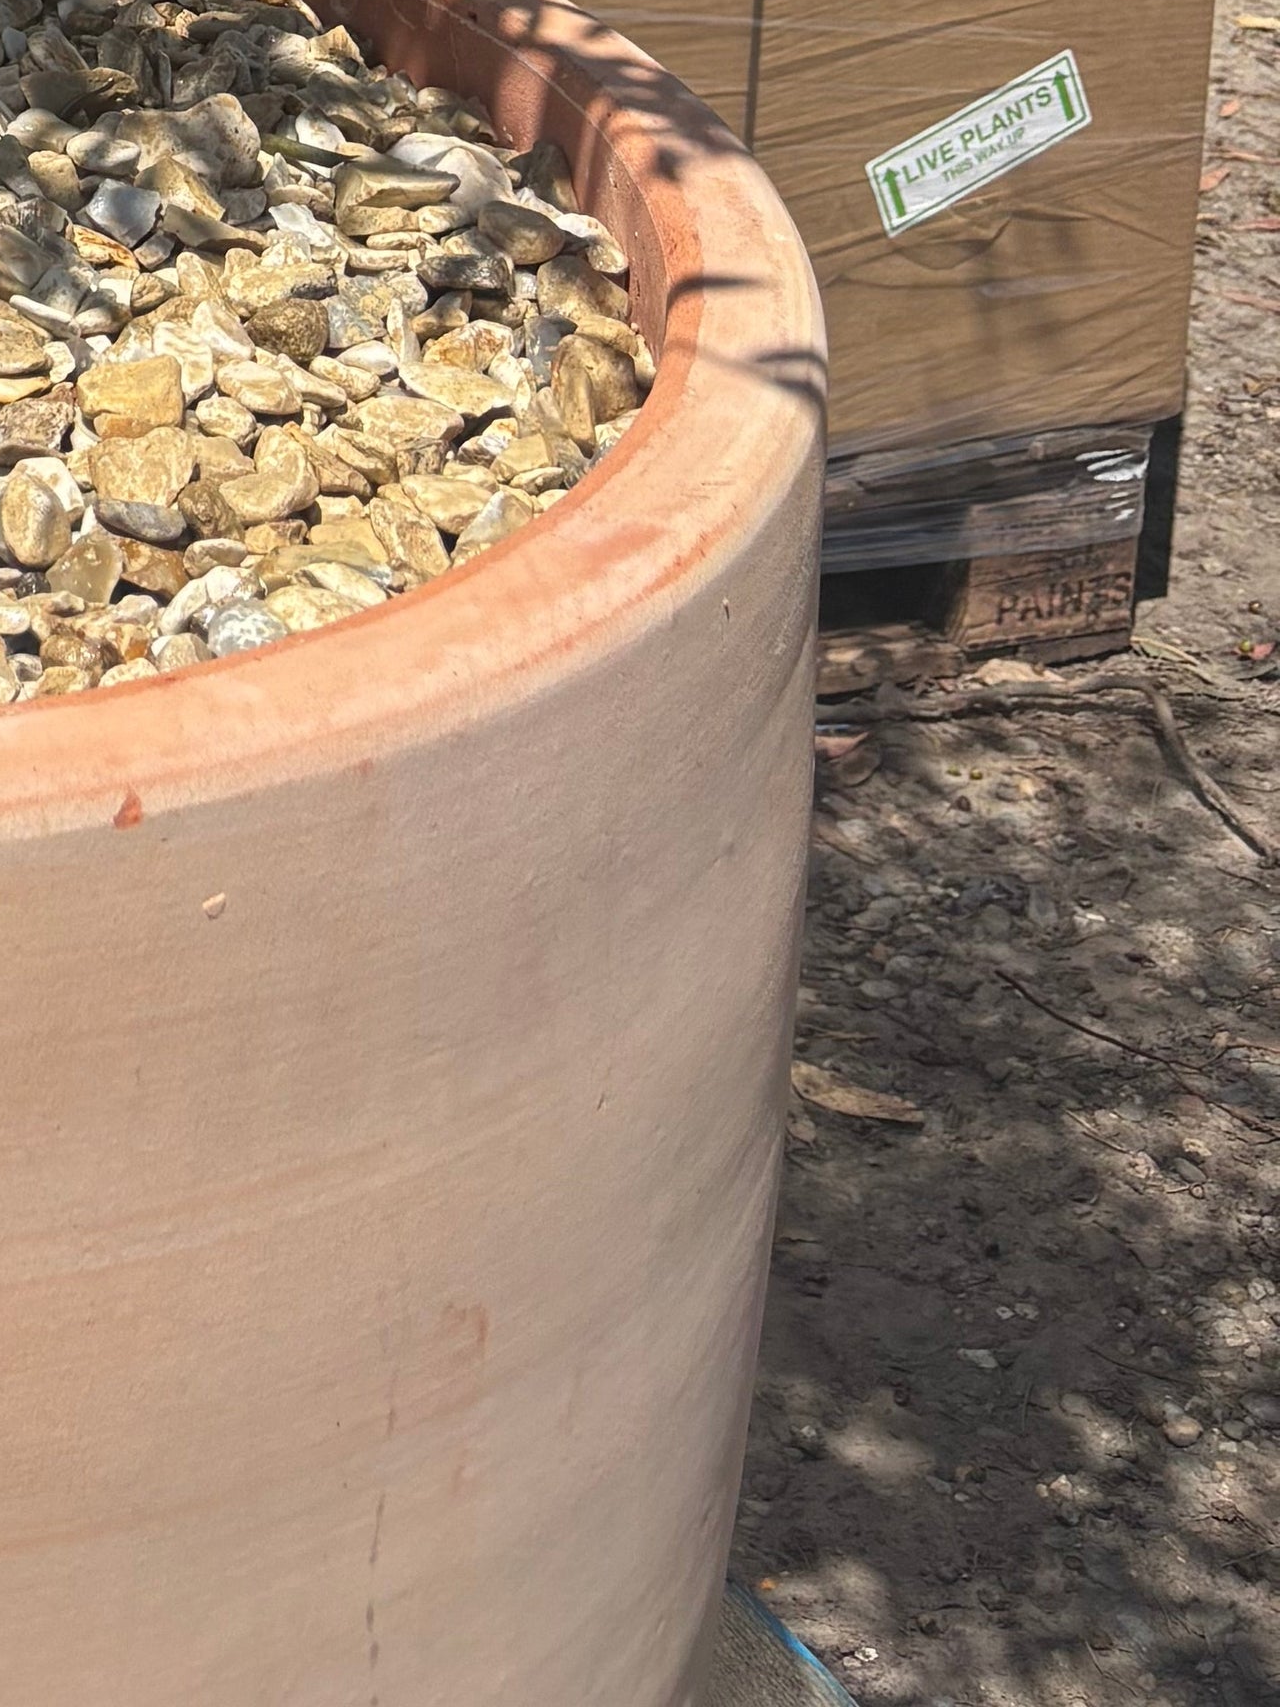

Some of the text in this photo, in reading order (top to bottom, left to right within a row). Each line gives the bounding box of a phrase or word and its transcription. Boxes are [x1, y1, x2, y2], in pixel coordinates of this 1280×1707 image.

[901, 85, 1053, 184] LIVE PLANTS
[941, 156, 974, 183] THIS
[976, 141, 1005, 164] WAY
